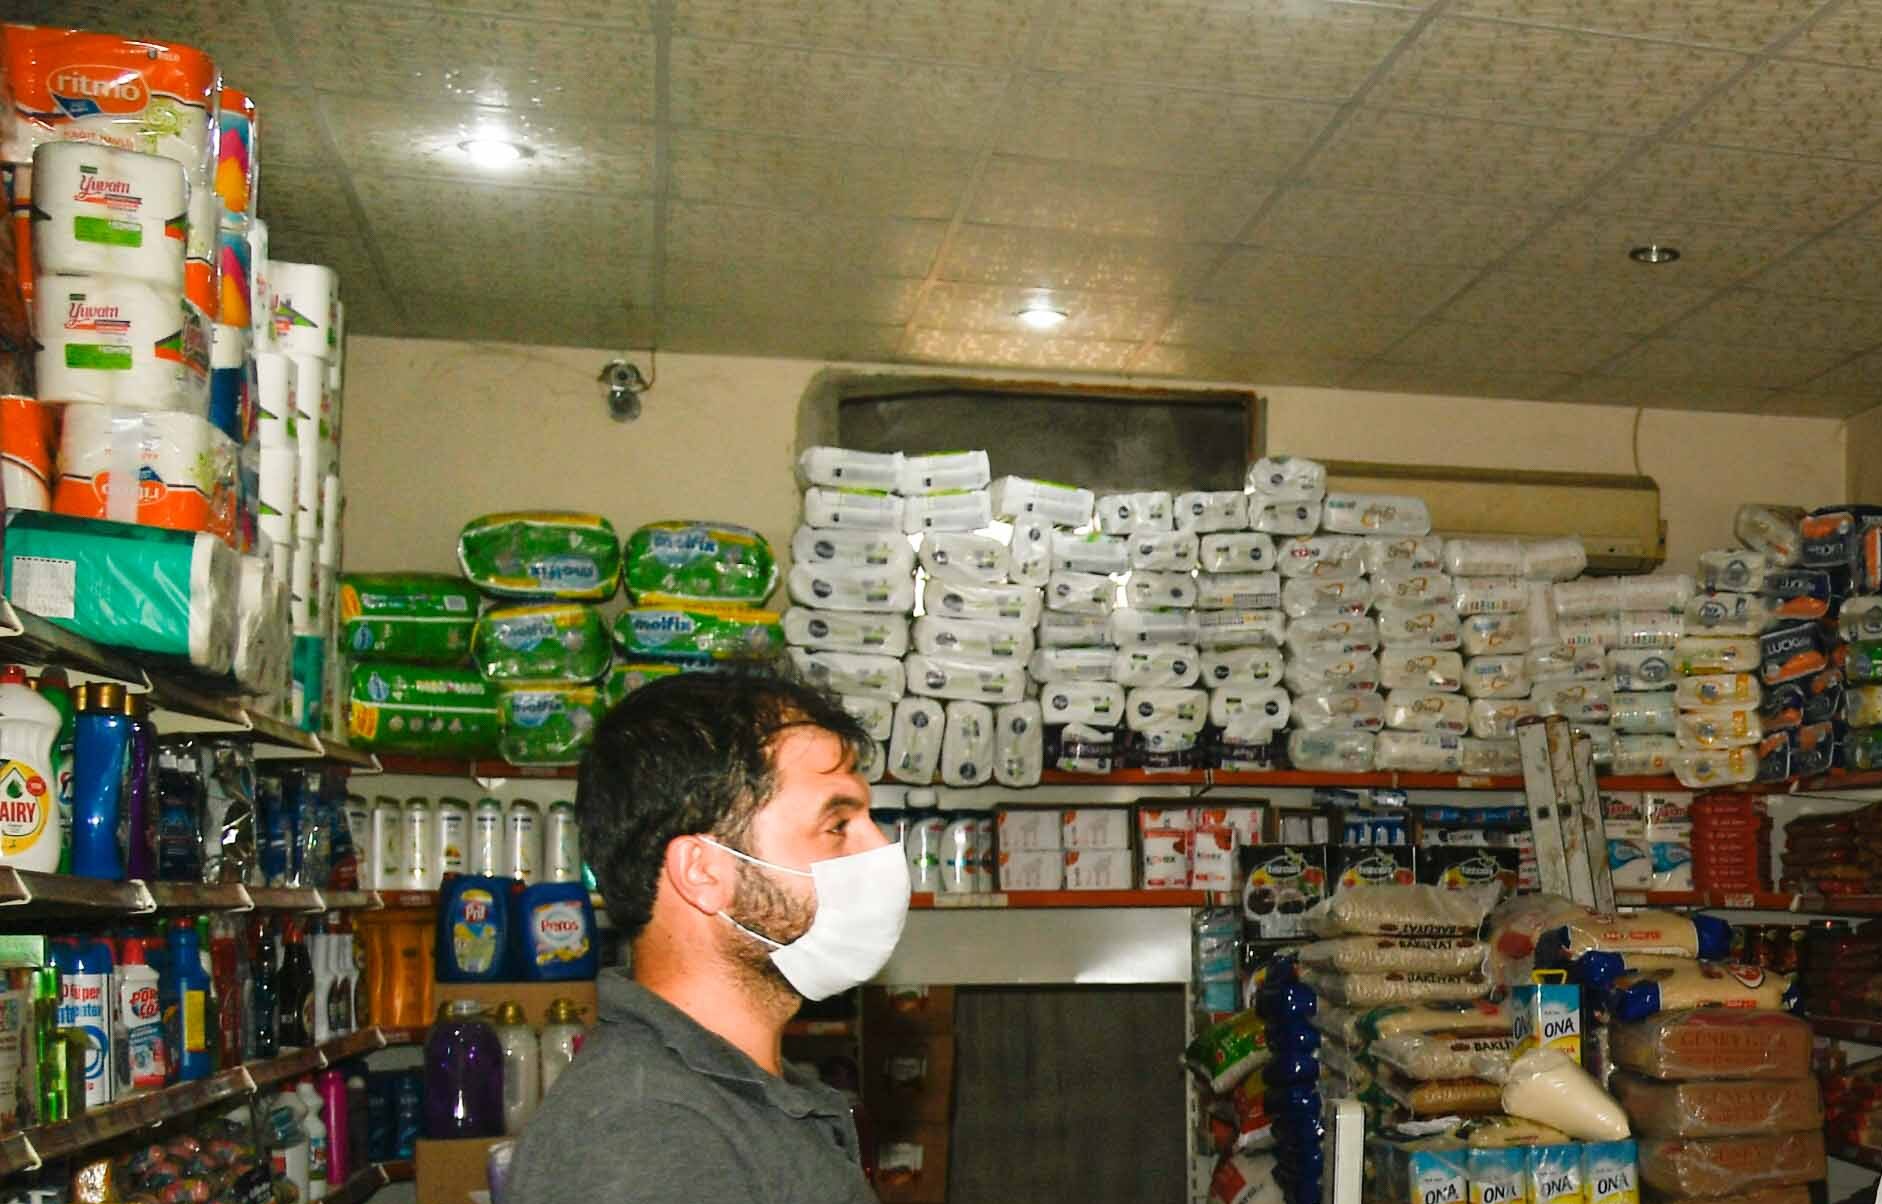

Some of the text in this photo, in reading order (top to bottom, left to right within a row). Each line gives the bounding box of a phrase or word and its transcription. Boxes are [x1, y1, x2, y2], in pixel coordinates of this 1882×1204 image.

[57, 73, 140, 101] ritmo
[633, 618, 692, 633] molfix
[0, 804, 36, 823] AIRY
[1544, 1017, 1576, 1038] ONA
[1474, 1039, 1514, 1053] BAKLİY
[1483, 1184, 1516, 1204] ONA
[1541, 1174, 1574, 1196] ONA
[1597, 1174, 1630, 1196] ONA
